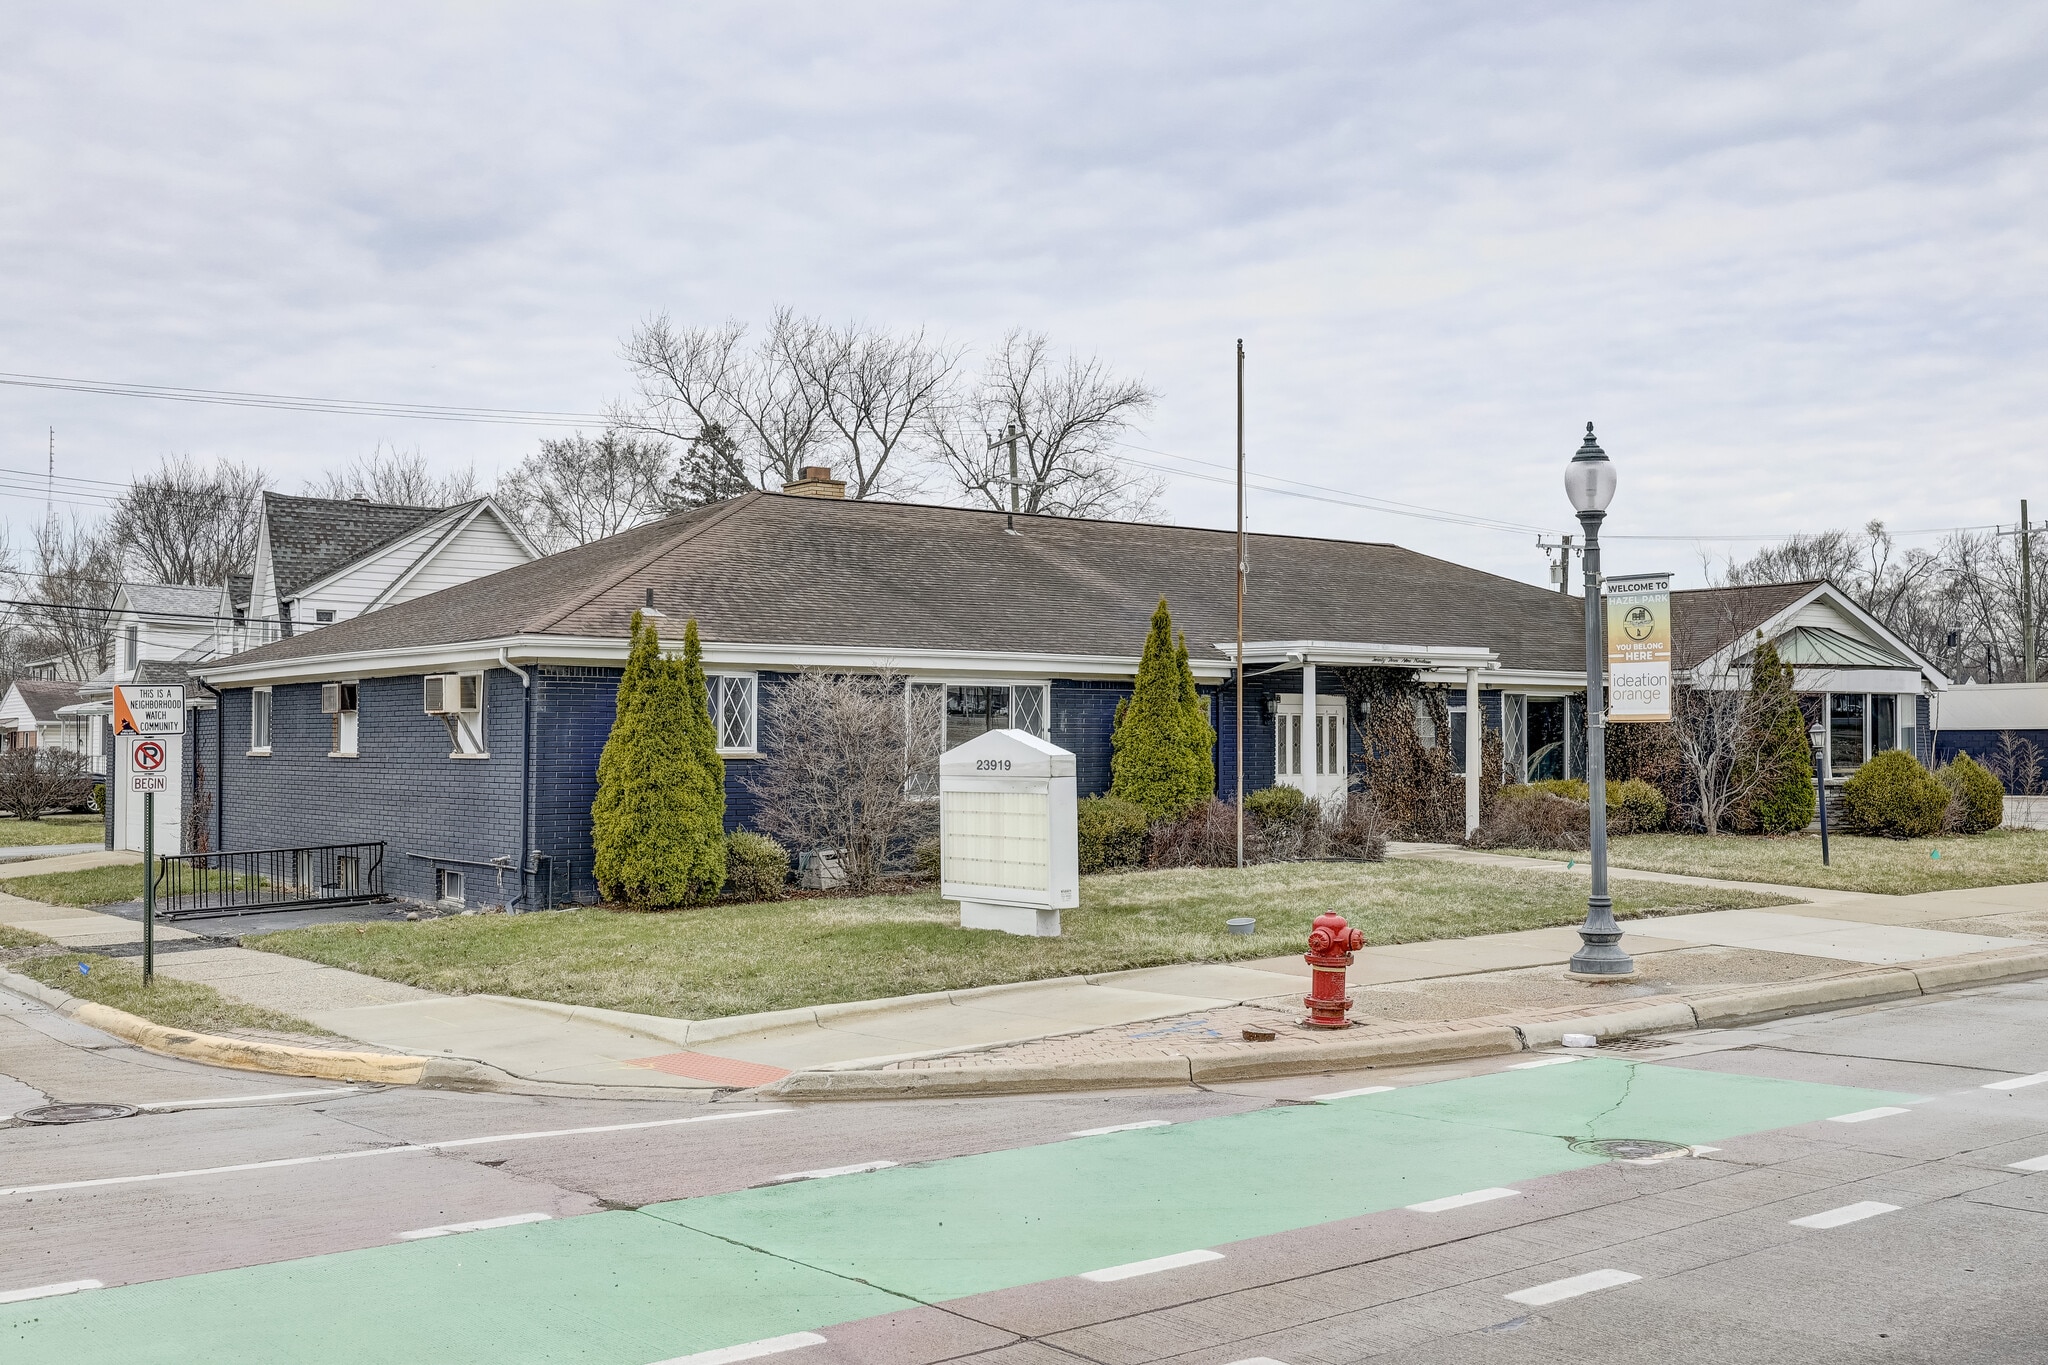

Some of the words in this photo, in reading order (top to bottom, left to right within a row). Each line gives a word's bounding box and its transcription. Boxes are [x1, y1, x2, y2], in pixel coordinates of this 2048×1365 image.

[1608, 582, 1653, 593] WELCOME
[1656, 581, 1668, 590] TO
[1609, 595, 1640, 605] HAZEL
[1642, 594, 1668, 603] PARK
[1616, 643, 1632, 651] YOU
[1633, 642, 1664, 650] BELONG
[1625, 651, 1653, 661] HERE
[1613, 672, 1667, 687] ideation
[140, 689, 154, 698] THIS
[157, 689, 164, 698] IS
[166, 689, 172, 698] A
[1612, 689, 1661, 705] orange
[130, 700, 182, 709] NEIGHBORHOOD
[145, 711, 167, 720] WATCH
[140, 721, 179, 731] COMMUNITY
[143, 746, 158, 765] P
[976, 759, 1011, 771] 23919
[134, 778, 164, 790] BEGIN
